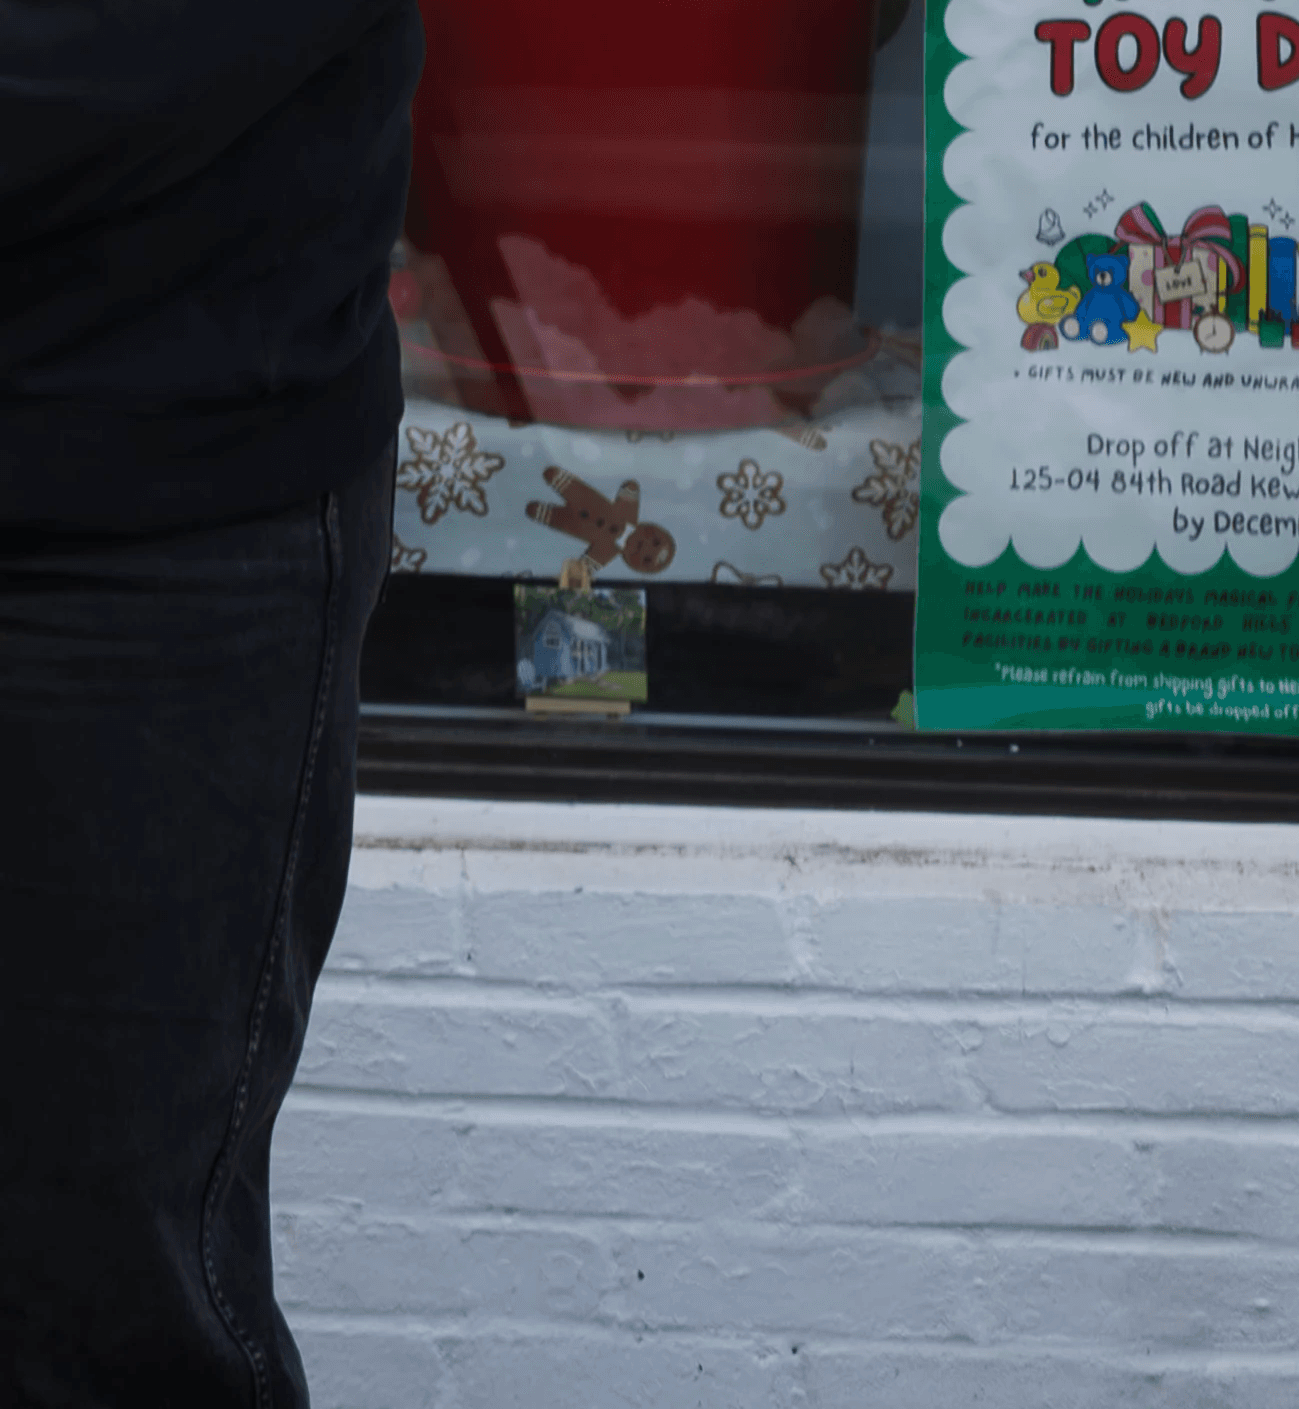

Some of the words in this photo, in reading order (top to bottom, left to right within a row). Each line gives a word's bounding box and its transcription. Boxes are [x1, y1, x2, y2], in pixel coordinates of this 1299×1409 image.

[1035, 11, 1222, 100] TOY
[1032, 122, 1071, 150] for
[1081, 122, 1122, 150] the
[1132, 122, 1240, 150] children
[1247, 120, 1280, 150] of
[1028, 364, 1074, 383] GIFTS
[1081, 366, 1126, 384] MUST
[1133, 368, 1155, 384] BE
[1161, 370, 1196, 387] NEW
[1202, 372, 1235, 389] AND
[1087, 432, 1146, 468] Drop
[1153, 430, 1200, 459] off
[1207, 435, 1234, 459] at
[1243, 435, 1299, 477] Neig
[1009, 465, 1100, 494] 125-04
[1111, 467, 1172, 495] 84th
[1181, 469, 1242, 498] Road
[1173, 505, 1205, 542] by
[1214, 509, 1299, 538] Decem
[965, 580, 1006, 597] HELP
[1204, 588, 1277, 607] MAGICAL
[1107, 611, 1127, 627] AT
[1237, 642, 1274, 660] NEW
[1052, 667, 1106, 686] refrain
[1110, 668, 1147, 688] from
[1153, 672, 1213, 700] shipping
[1217, 674, 1254, 700] gifts
[1260, 677, 1276, 693] to
[1146, 698, 1182, 720] gifts
[1186, 700, 1204, 715] be
[1209, 702, 1271, 723] dropped
[1274, 704, 1299, 720] off
